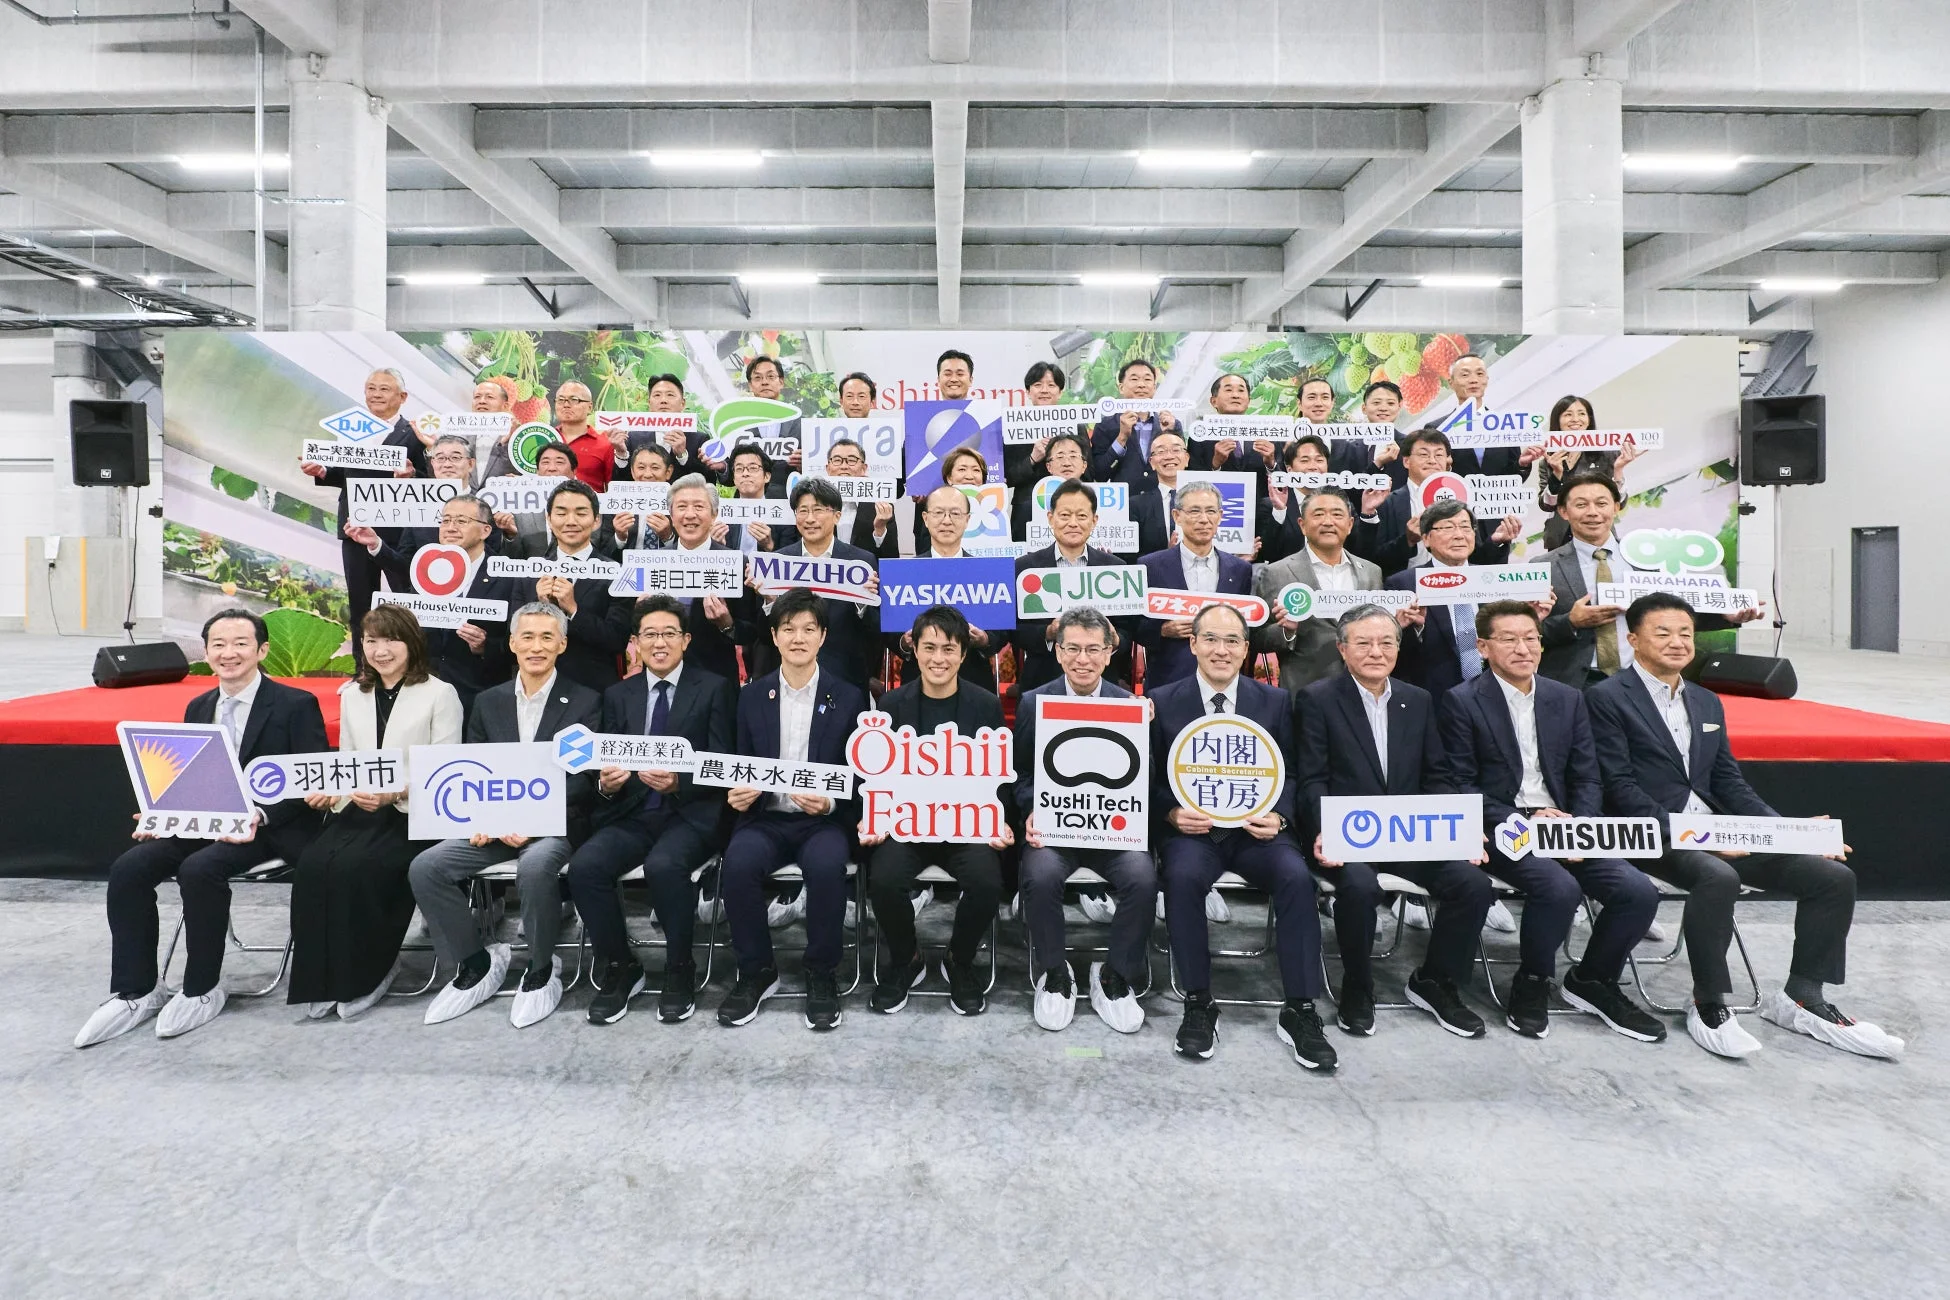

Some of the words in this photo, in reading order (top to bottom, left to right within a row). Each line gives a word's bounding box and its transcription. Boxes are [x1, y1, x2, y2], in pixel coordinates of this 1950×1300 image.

[447, 415, 510, 426] 大阪公立大学
[627, 416, 693, 427] YANMAR
[1006, 408, 1077, 422] HAKUHODO
[1082, 407, 1097, 420] DY
[1483, 413, 1528, 431] OAT
[339, 418, 375, 434] DJK
[1208, 426, 1290, 437] 大石産業株式会社
[1317, 425, 1392, 437] OMAKASE
[1550, 433, 1637, 448] NOMURA
[306, 454, 334, 462] DAIICHI
[336, 456, 371, 465] JITSUGYO
[307, 443, 403, 460] 第一実業株式会社
[838, 481, 894, 499] 國銀行
[1470, 478, 1519, 488] MOBILE
[353, 483, 458, 503] MIYAKO
[1099, 486, 1126, 511] BJ
[1474, 491, 1534, 502] INTERNET
[354, 507, 443, 523] CAPITA
[721, 504, 783, 519] 商工中金
[1472, 505, 1525, 515] CAPITAL
[627, 554, 668, 564] Passion
[670, 556, 677, 564] &
[678, 554, 738, 567] Technology
[592, 563, 620, 575] Inc.
[753, 557, 870, 585] MIZUHO
[1498, 571, 1548, 583] SAKATA
[650, 568, 738, 591] 朝日工業社
[1067, 569, 1144, 600] JICN
[1422, 575, 1464, 586] サカタのタネ
[1629, 575, 1722, 588] NAKAHARA
[883, 582, 1013, 606] YASKAWA
[1318, 595, 1367, 605] MIYOSHI
[1370, 594, 1413, 605] GROUP
[413, 600, 447, 612] House
[448, 602, 498, 615] Ventures
[600, 739, 686, 759] 経済産業省
[851, 728, 1010, 777] Oishii
[1192, 731, 1257, 766] 内閣
[293, 756, 398, 792] 羽村市
[699, 759, 847, 793] 農林水産省
[1185, 765, 1217, 774] Cabinet
[1220, 767, 1267, 776] Secretariat
[462, 777, 551, 802] NEDO
[1192, 775, 1260, 810] 官房
[1039, 791, 1091, 810] SusHi
[1095, 794, 1142, 813] Tech
[866, 790, 1001, 838] Farm
[143, 815, 248, 835] SPARX
[1389, 813, 1464, 843] NTT
[1039, 831, 1076, 840] Sustainable
[1076, 834, 1092, 842] High
[1092, 834, 1106, 843] City
[1106, 835, 1122, 843] Tech
[1122, 836, 1142, 844] Tokyo
[1537, 822, 1656, 851] MiSUMi
[1714, 832, 1775, 846] 野村不動産
